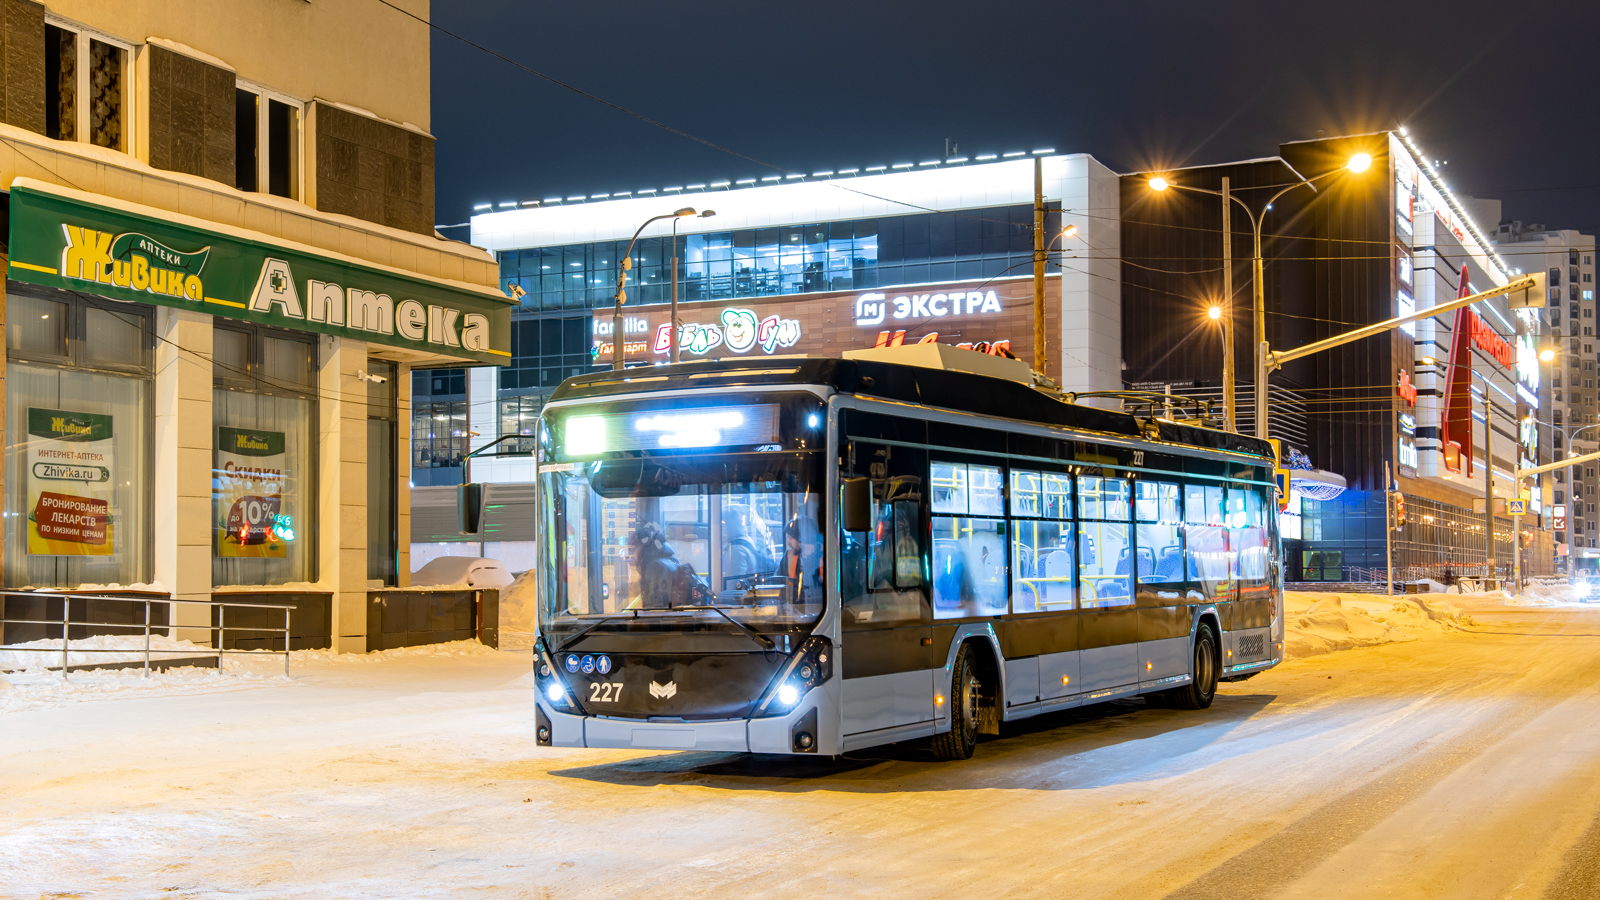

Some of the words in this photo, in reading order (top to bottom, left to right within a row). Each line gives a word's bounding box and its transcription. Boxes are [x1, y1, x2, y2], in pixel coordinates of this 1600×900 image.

[139, 239, 181, 265] АПТЕКИ
[61, 223, 203, 301] Живика
[249, 257, 491, 353] Аптека
[892, 290, 1002, 319] ЭКСТРА
[593, 317, 648, 335] failia
[38, 449, 104, 461] ИНТЕРНЕТ-АПТЕКА
[1133, 450, 1144, 466] 227
[43, 465, 93, 479] Zhivika.ru
[224, 461, 281, 483] Скидки
[42, 497, 106, 515] БРОНИРОВАНИЕ
[239, 500, 275, 525] 10%
[51, 511, 97, 527] ЛЕКАРСТВ
[41, 524, 51, 533] ПО
[53, 526, 80, 536] НИЗКИМ
[82, 529, 104, 539] ЦЕНАМ
[589, 682, 624, 703] 227
